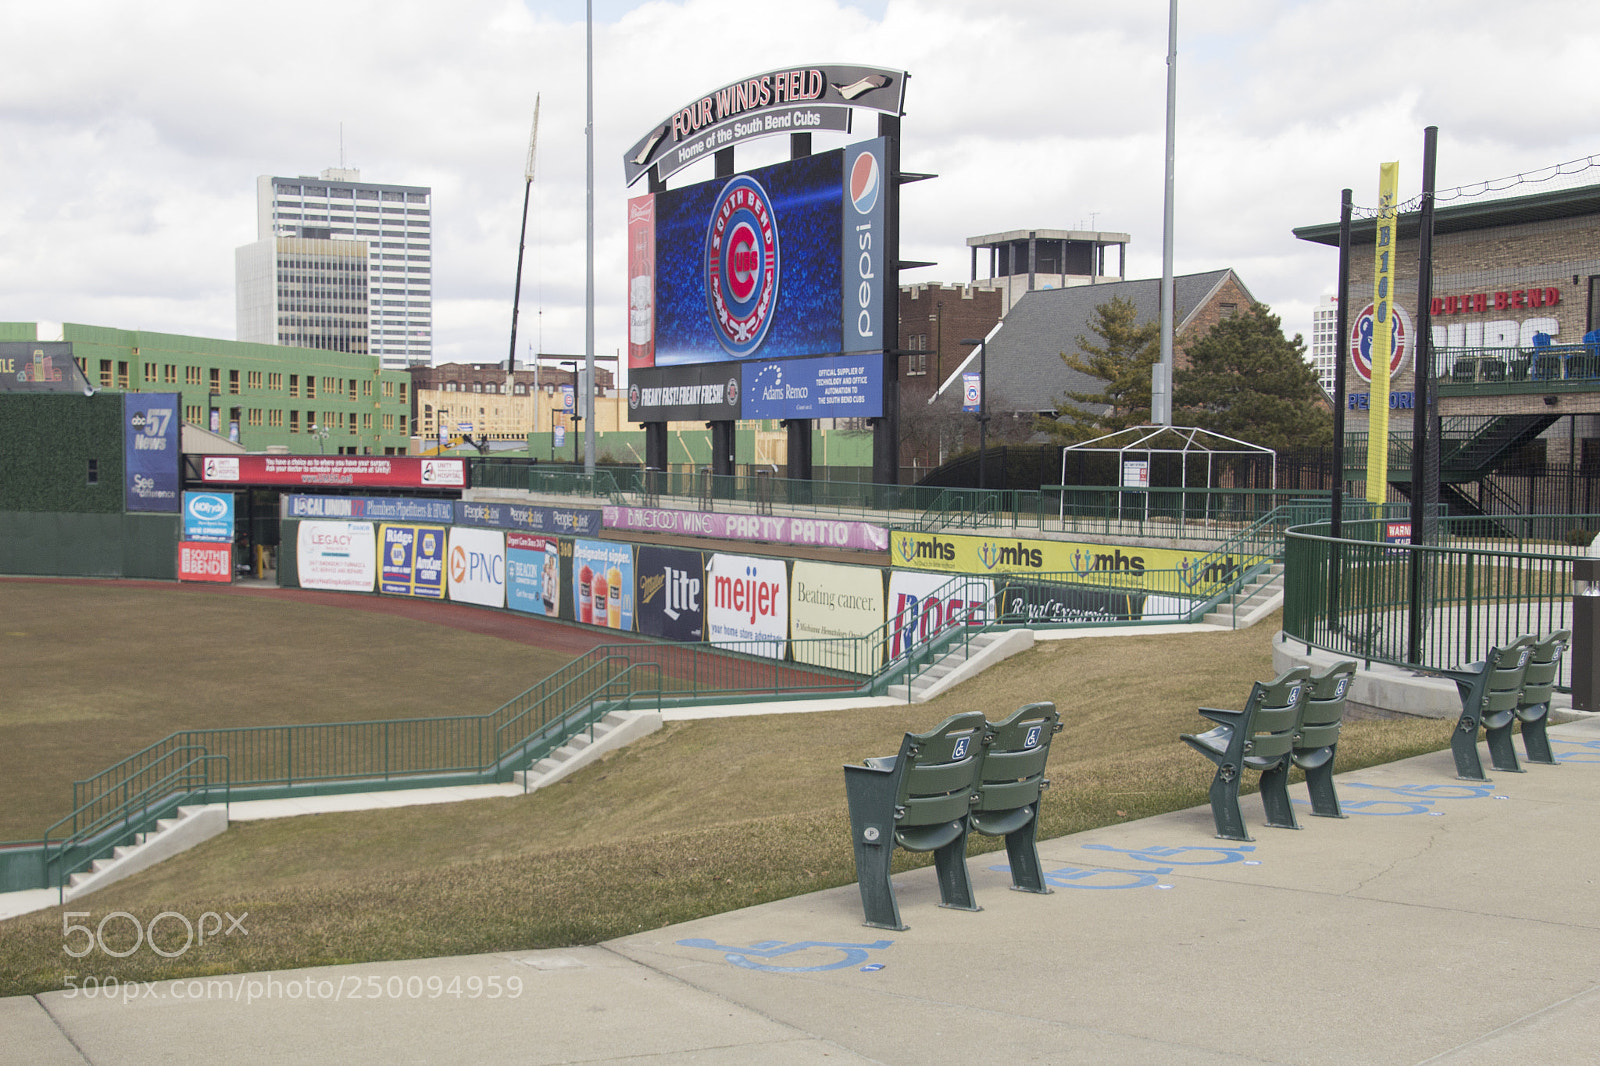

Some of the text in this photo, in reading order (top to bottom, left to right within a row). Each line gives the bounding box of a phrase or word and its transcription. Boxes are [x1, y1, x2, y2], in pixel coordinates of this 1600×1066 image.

[672, 69, 823, 142] FOUR WINDS FIELD
[678, 110, 821, 163] Home of the South Bend Cubs
[713, 190, 772, 251] SOUTH BEND
[855, 220, 875, 338] pepsi
[1494, 286, 1560, 310] BEND
[858, 367, 865, 375] OF
[641, 388, 662, 407] FREAKY
[679, 385, 701, 405] FREAKY
[762, 383, 809, 401] Adams Remco
[826, 396, 840, 404] SOUTH
[851, 386, 858, 394] TO
[131, 408, 172, 437] abc 57
[134, 434, 167, 450] News
[134, 473, 154, 489] See
[294, 497, 365, 517] LOCAL UNION 172
[427, 503, 432, 518] &
[386, 529, 413, 546] Ridge
[682, 512, 713, 534] WINE
[725, 515, 785, 540] PARTY
[790, 520, 849, 545] PATIO
[1389, 525, 1411, 536] WARN
[311, 534, 352, 546] LEGACY
[917, 537, 955, 561] mhs
[190, 549, 219, 561] SOUTH
[1000, 542, 1042, 568] mhs
[1095, 549, 1145, 577] mhs
[190, 560, 220, 575] BEND
[469, 551, 503, 585] PNC
[663, 566, 700, 621] Lite
[715, 566, 780, 625] meijer
[797, 581, 876, 612] Beating cancer.
[711, 624, 723, 637] your
[723, 625, 738, 637] home
[739, 627, 753, 639] store
